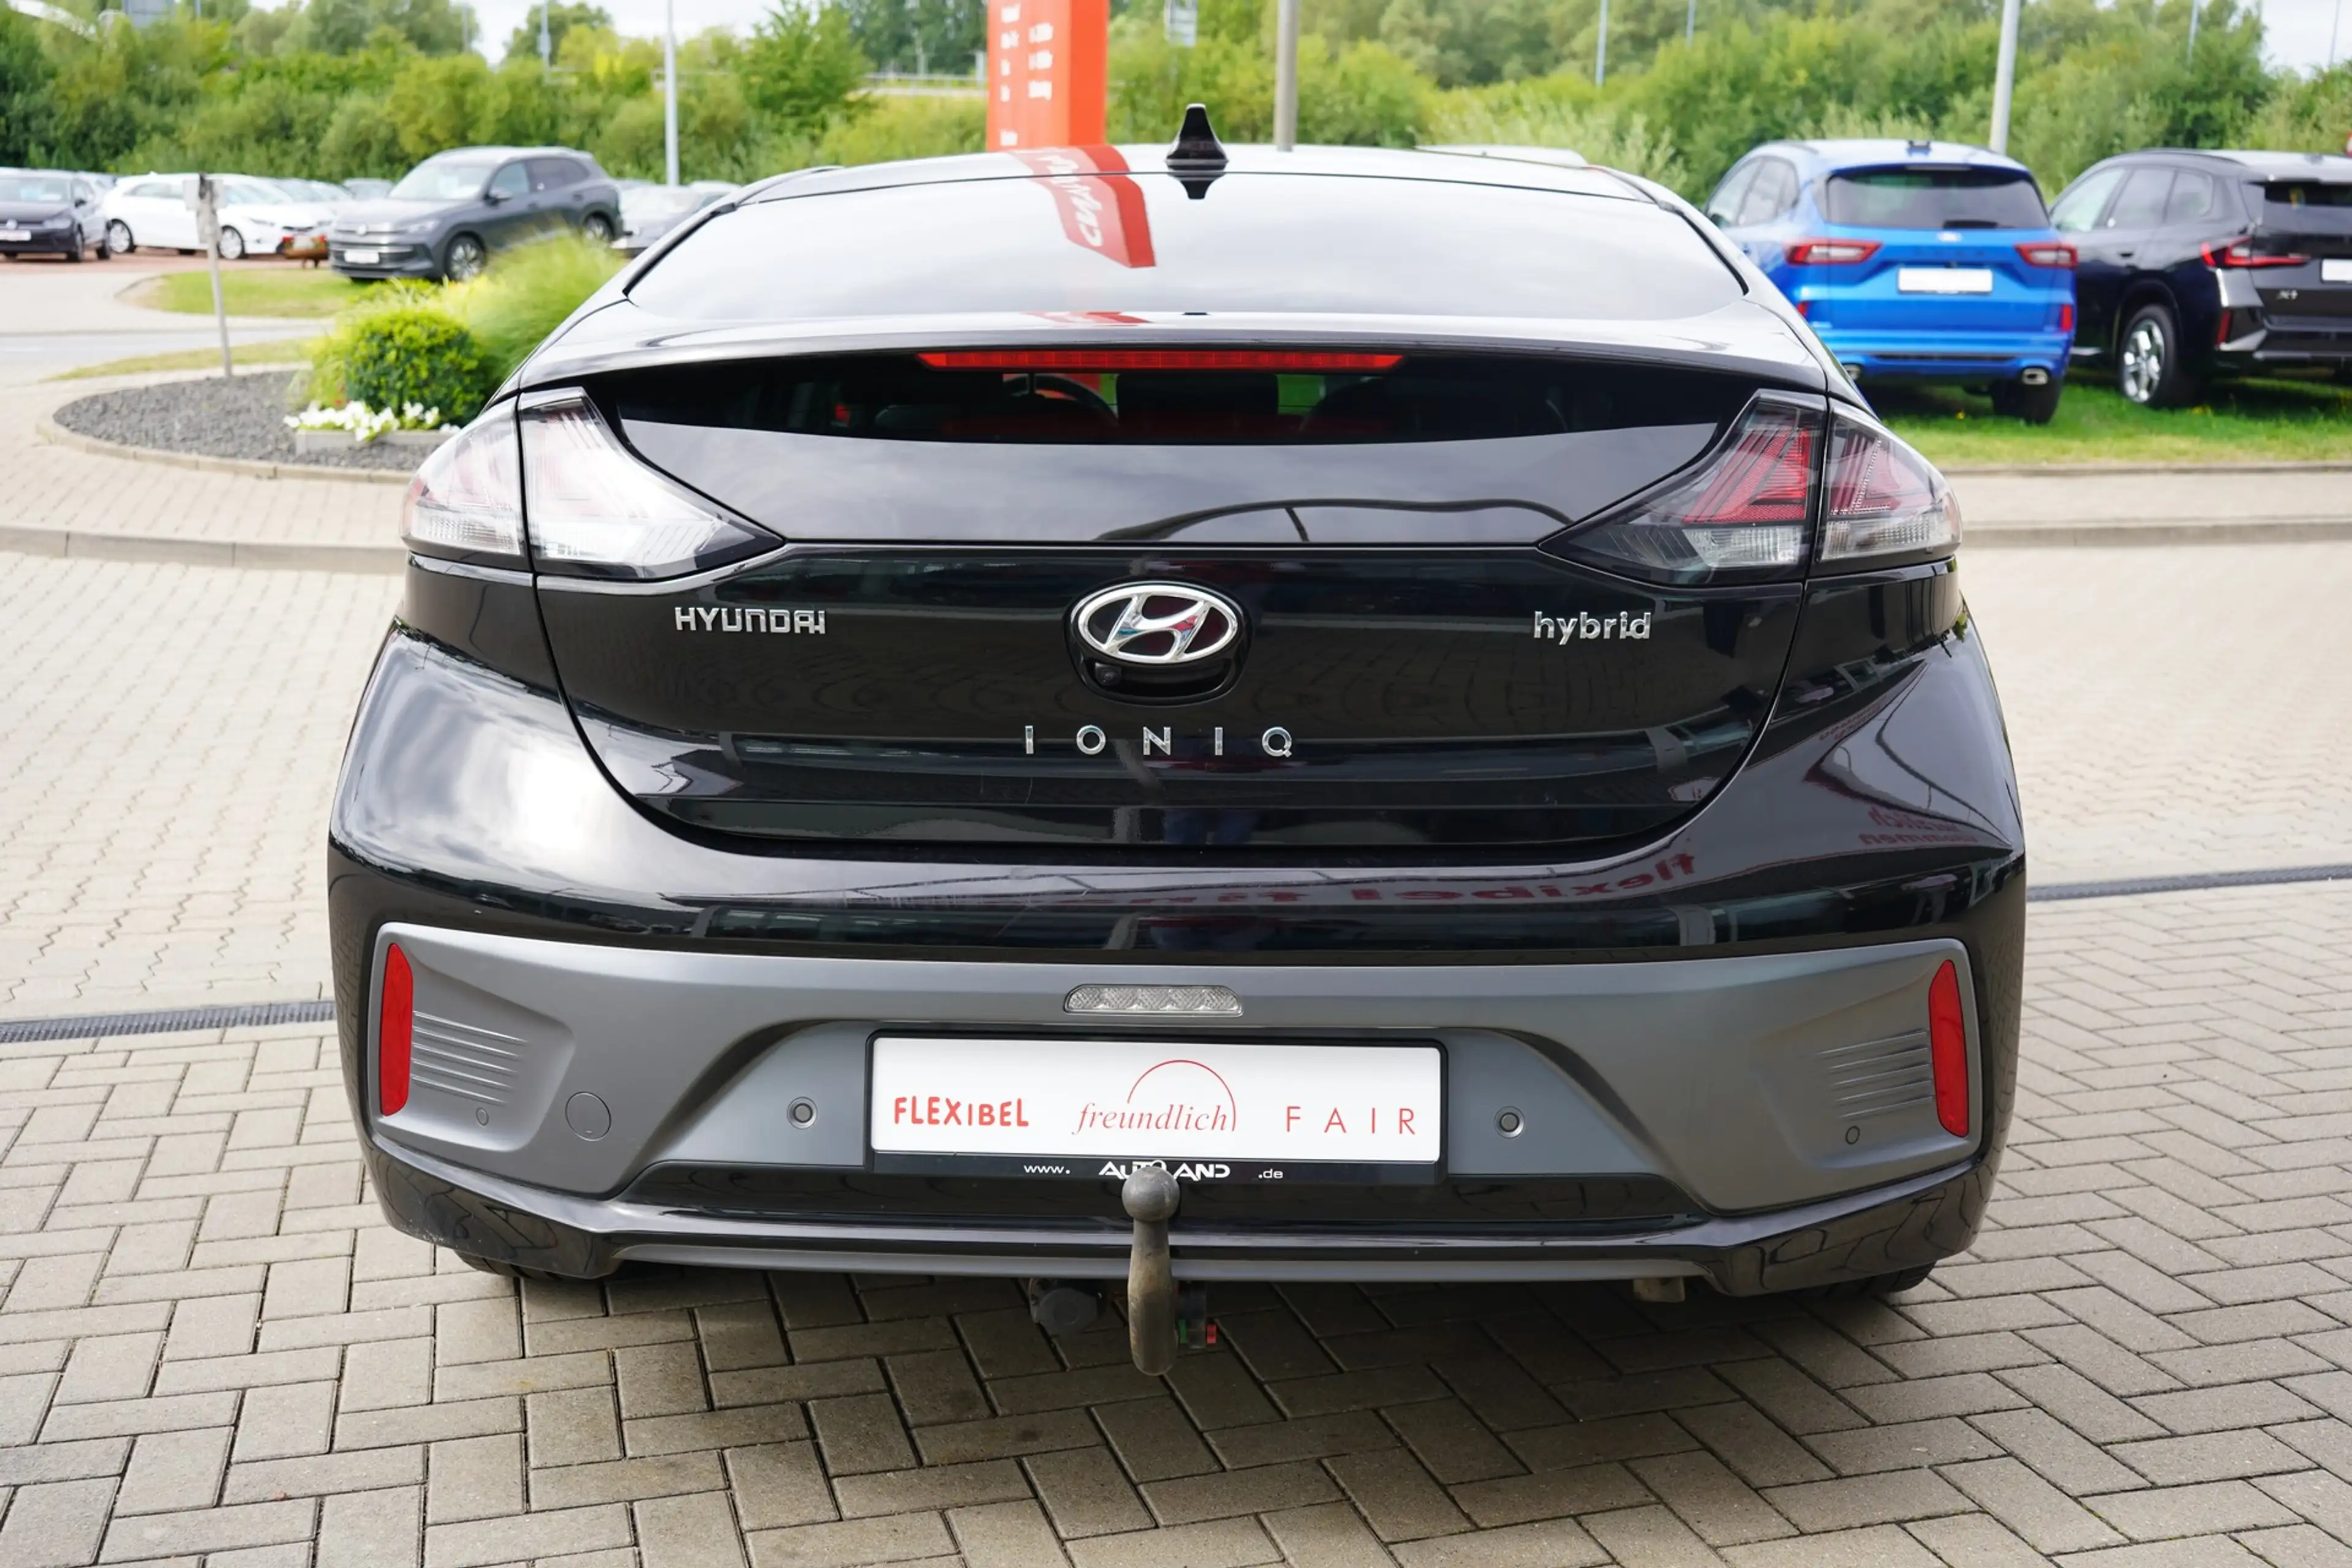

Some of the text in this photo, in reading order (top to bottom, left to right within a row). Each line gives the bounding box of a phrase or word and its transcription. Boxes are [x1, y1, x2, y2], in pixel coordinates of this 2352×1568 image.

[674, 606, 826, 634] HYUNDAI
[1534, 611, 1651, 646] hybrid
[1025, 725, 1292, 758] IONIQ
[894, 1096, 1415, 1135] FLEXIBEL freundlich FAIR
[1023, 1165, 1071, 1175] www.
[1258, 1168, 1284, 1179] .de
